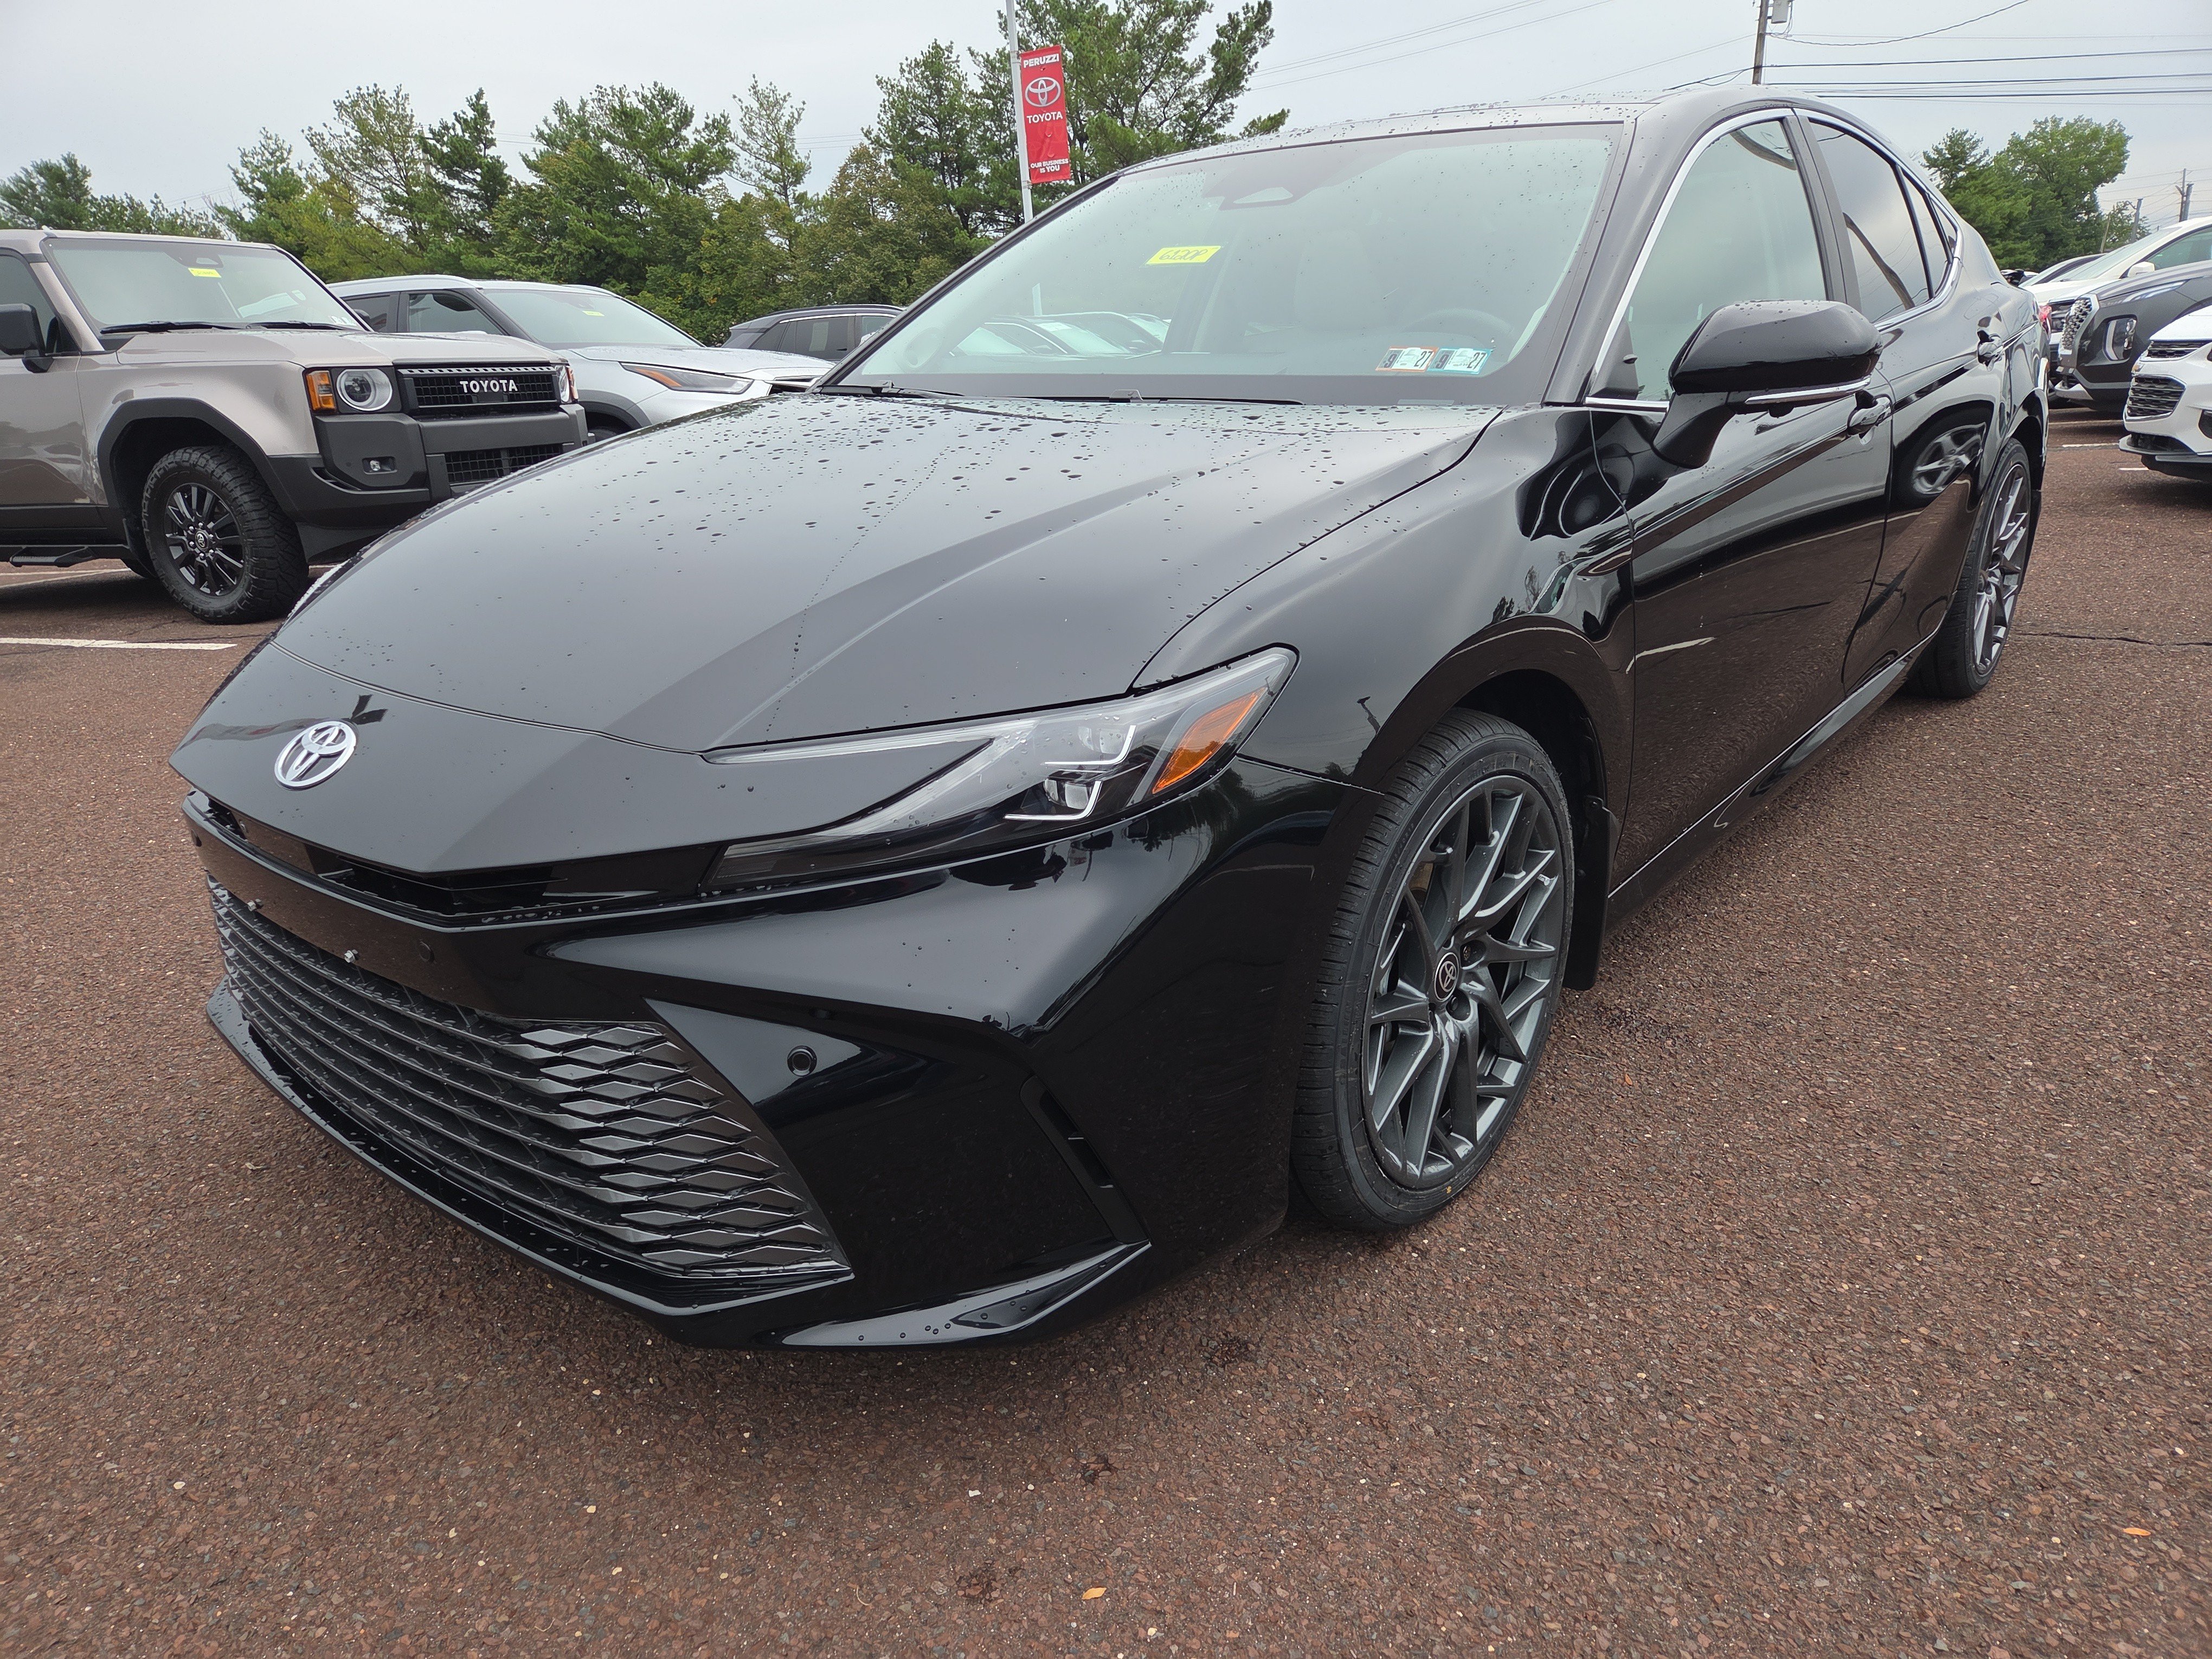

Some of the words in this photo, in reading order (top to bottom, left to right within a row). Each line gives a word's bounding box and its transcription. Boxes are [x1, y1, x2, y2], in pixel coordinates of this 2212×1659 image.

[1023, 53, 1059, 68] PERUZZI
[1026, 111, 1063, 124] TOYOTA
[1043, 158, 1069, 166] BUSINESS
[1413, 351, 1433, 369] 27
[1467, 352, 1487, 370] 27
[460, 379, 518, 394] TOYOTA
